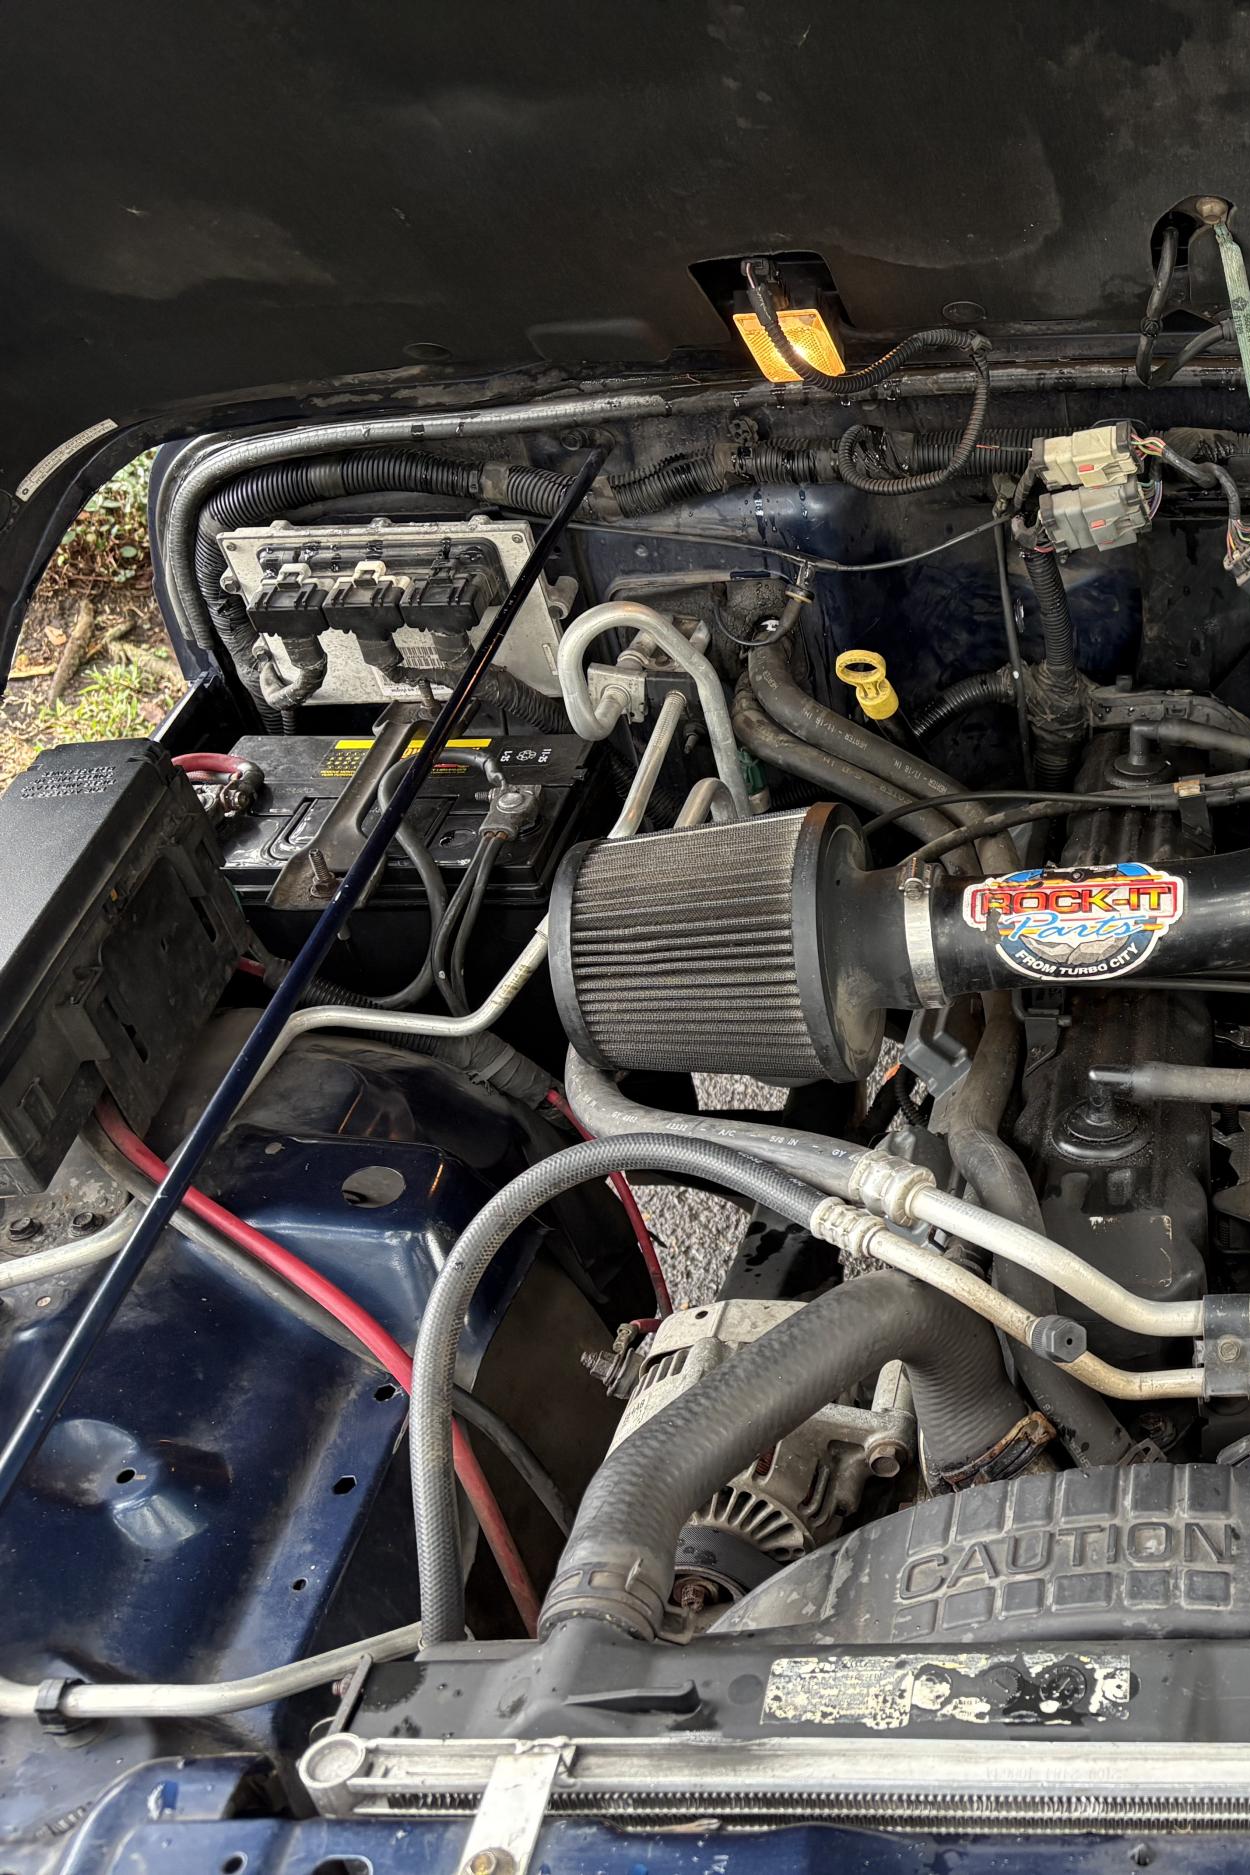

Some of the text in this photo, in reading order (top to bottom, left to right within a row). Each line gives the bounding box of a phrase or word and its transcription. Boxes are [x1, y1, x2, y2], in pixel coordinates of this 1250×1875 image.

[981, 886, 1172, 915] ROCK-IT
[1003, 911, 1147, 941] Parts
[1015, 942, 1139, 975] FROM TURBO CITY
[718, 1129, 736, 1138] A/C
[831, 1149, 847, 1158] GY
[898, 1520, 1236, 1600] CAUTION
